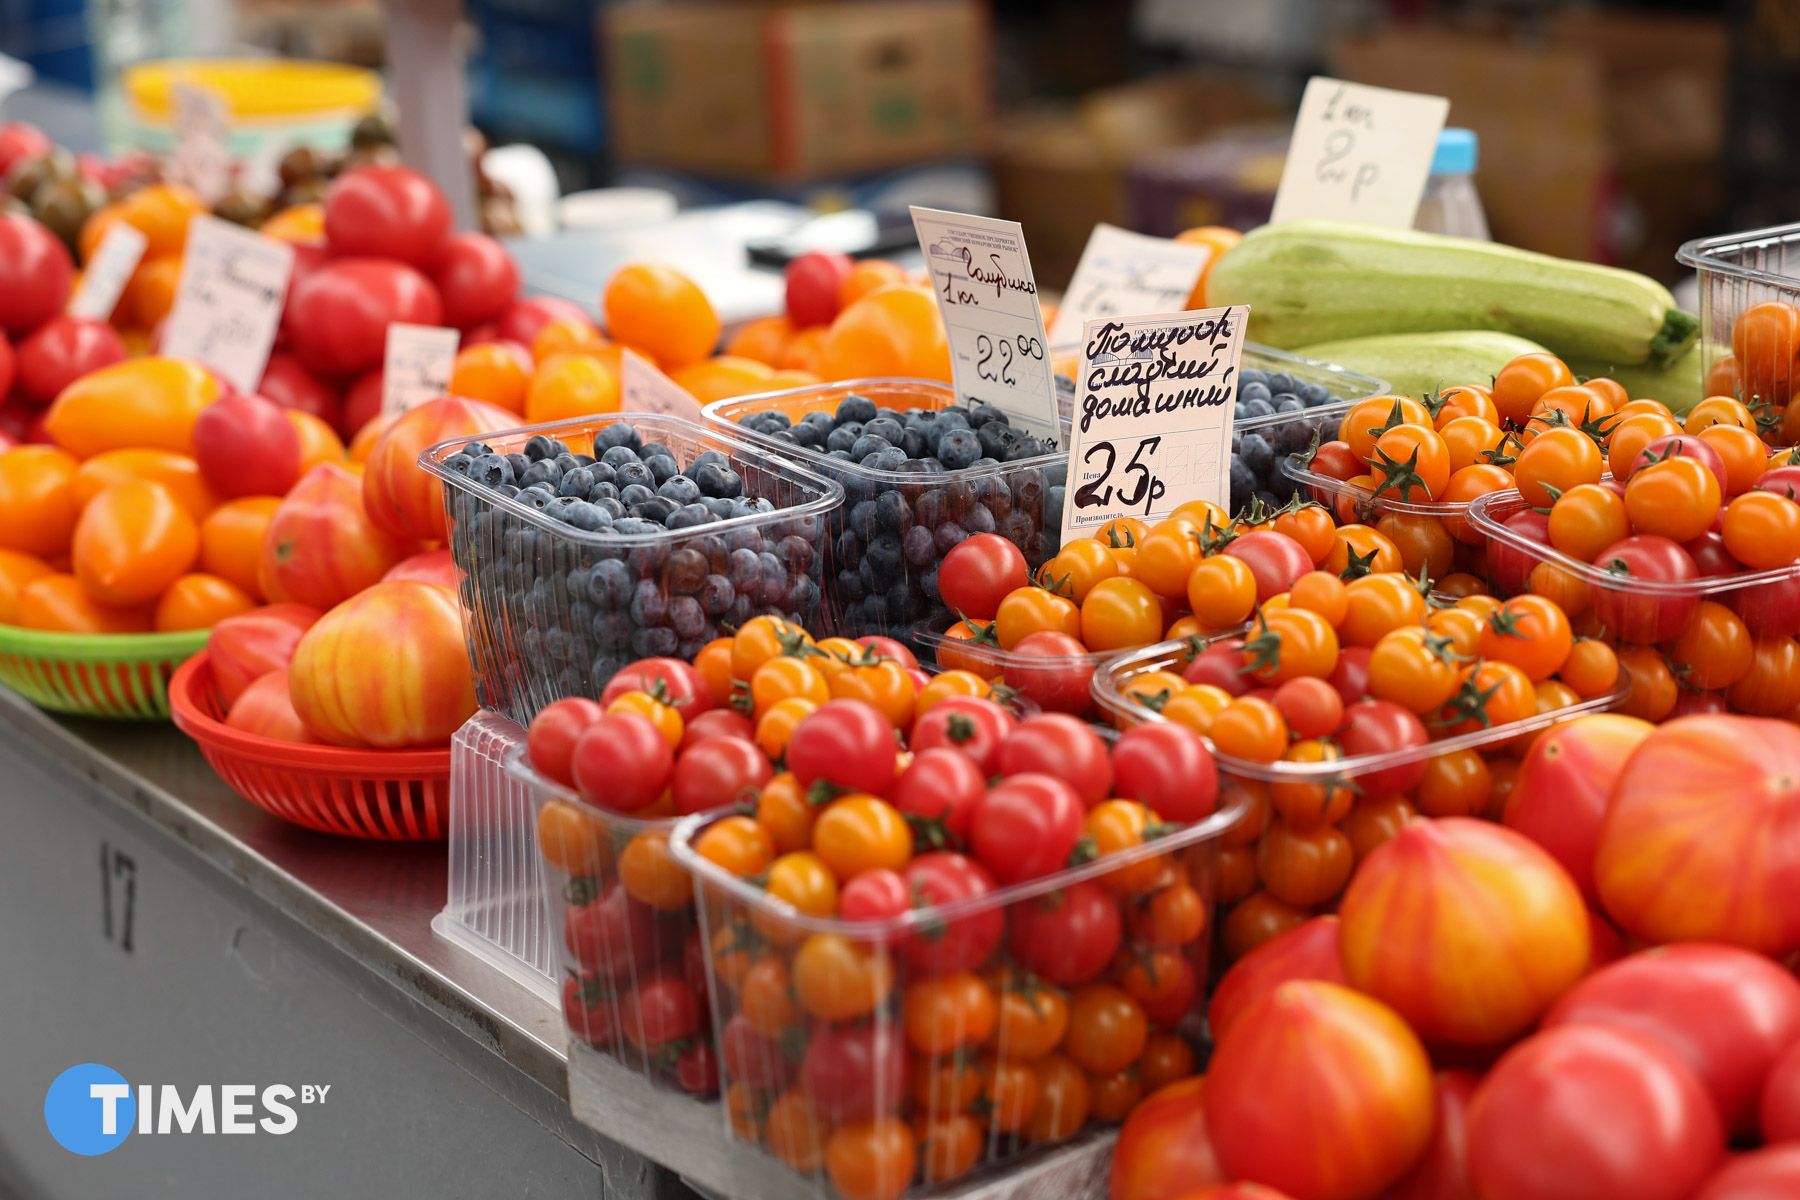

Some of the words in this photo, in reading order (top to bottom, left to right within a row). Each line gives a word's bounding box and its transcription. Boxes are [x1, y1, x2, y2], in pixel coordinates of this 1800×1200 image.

[1081, 366, 1234, 433] домашний
[1083, 472, 1101, 480] Цена
[1075, 512, 1124, 524] Производитель
[100, 840, 137, 955] 17
